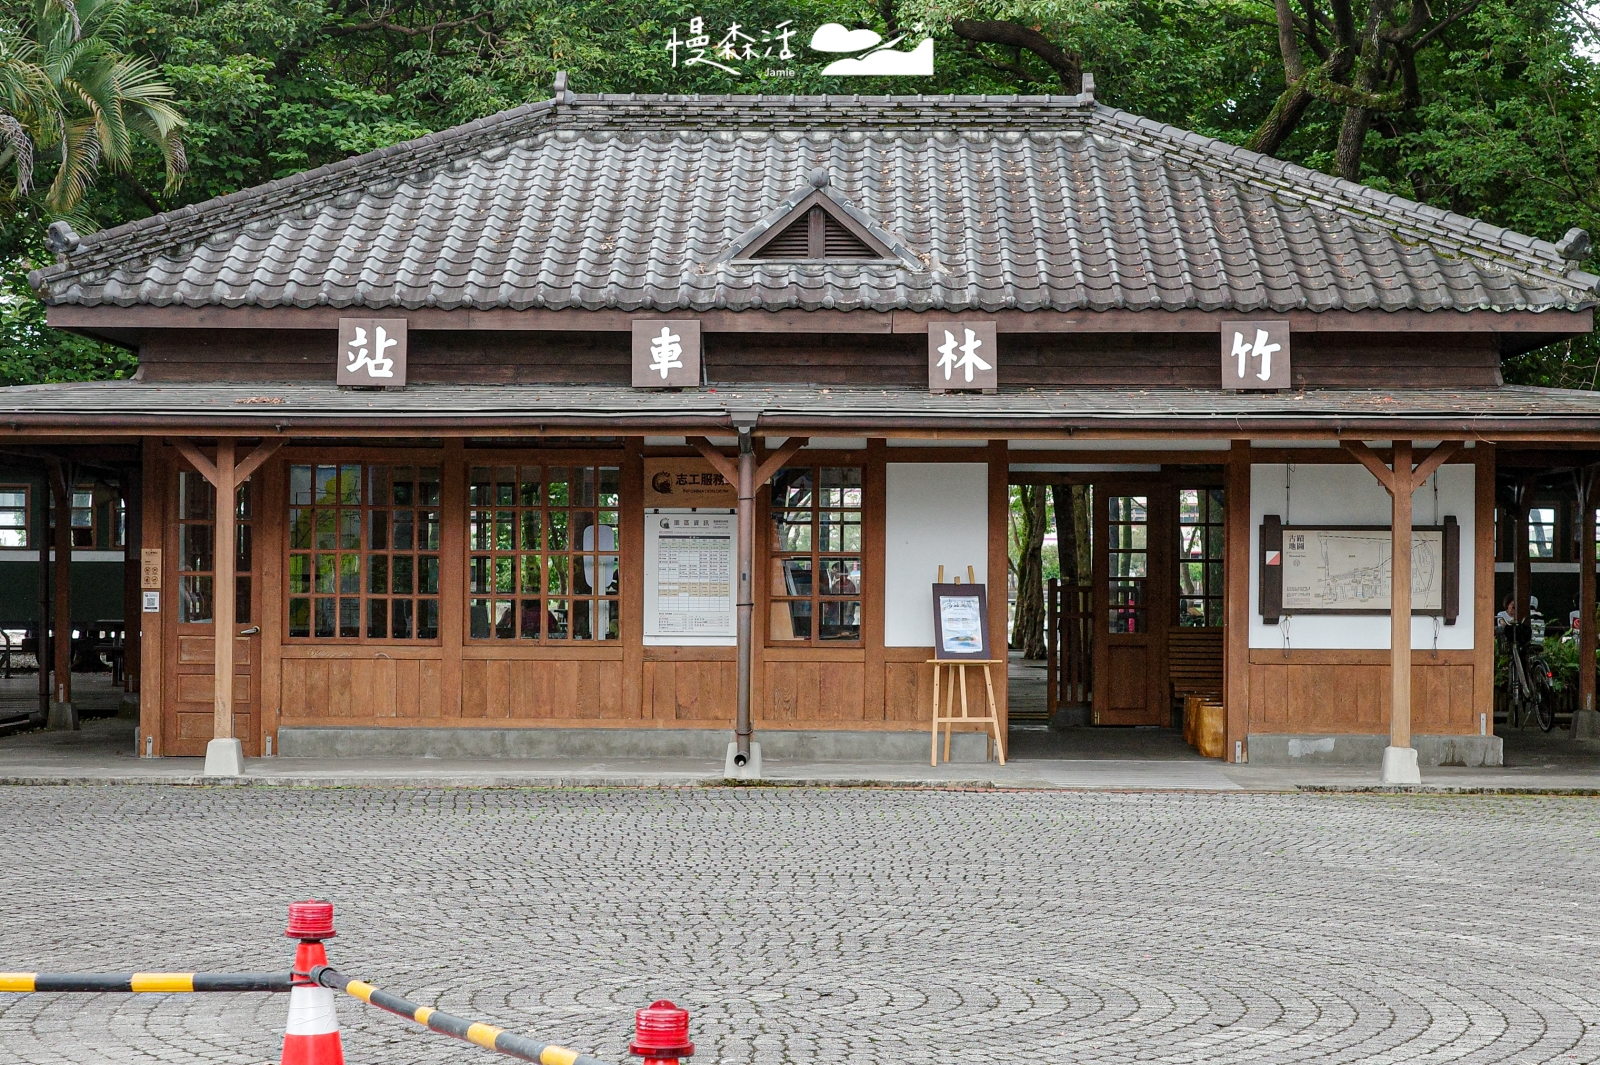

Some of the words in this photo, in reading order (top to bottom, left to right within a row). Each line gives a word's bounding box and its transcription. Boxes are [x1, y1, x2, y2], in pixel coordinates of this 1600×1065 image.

[346, 326, 398, 378] 站
[649, 326, 683, 380] 車
[936, 328, 993, 383] 林
[1230, 328, 1281, 381] 竹
[676, 473, 730, 486] 志工服務
